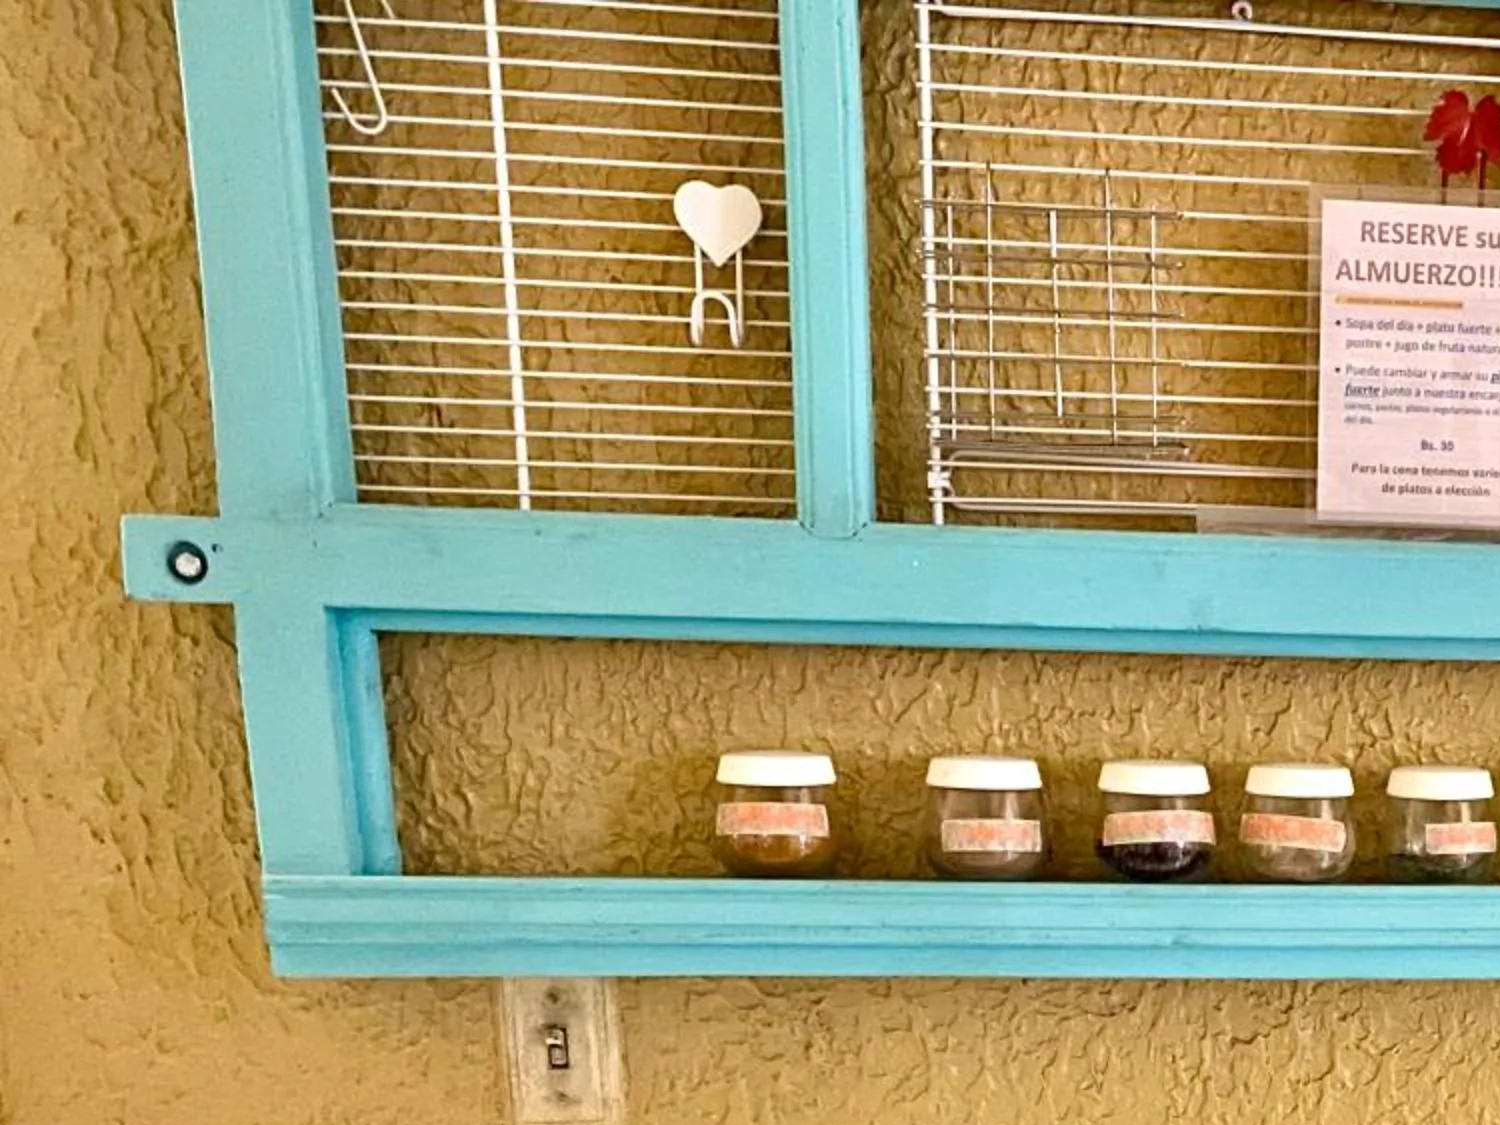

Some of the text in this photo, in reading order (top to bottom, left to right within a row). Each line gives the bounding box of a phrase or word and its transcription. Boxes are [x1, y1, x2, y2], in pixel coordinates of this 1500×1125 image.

[1360, 220, 1469, 248] RESERVE
[1346, 318, 1373, 330] Sopa
[1376, 319, 1394, 330] del
[1426, 321, 1454, 333] plato
[1458, 322, 1492, 334] fuerte
[1394, 341, 1418, 352] jugo
[1422, 341, 1435, 351] de
[1439, 341, 1465, 352] fruta
[1345, 364, 1380, 377] Puede
[1383, 366, 1427, 378] cambiar
[1430, 370, 1437, 381] y
[1440, 371, 1472, 381] armar
[1415, 389, 1421, 397] a
[1351, 463, 1377, 474] Para
[1380, 464, 1389, 474] la
[1392, 465, 1419, 475] cena
[1421, 466, 1470, 478] tenemos
[1382, 482, 1395, 493] de
[1398, 483, 1432, 495] platos
